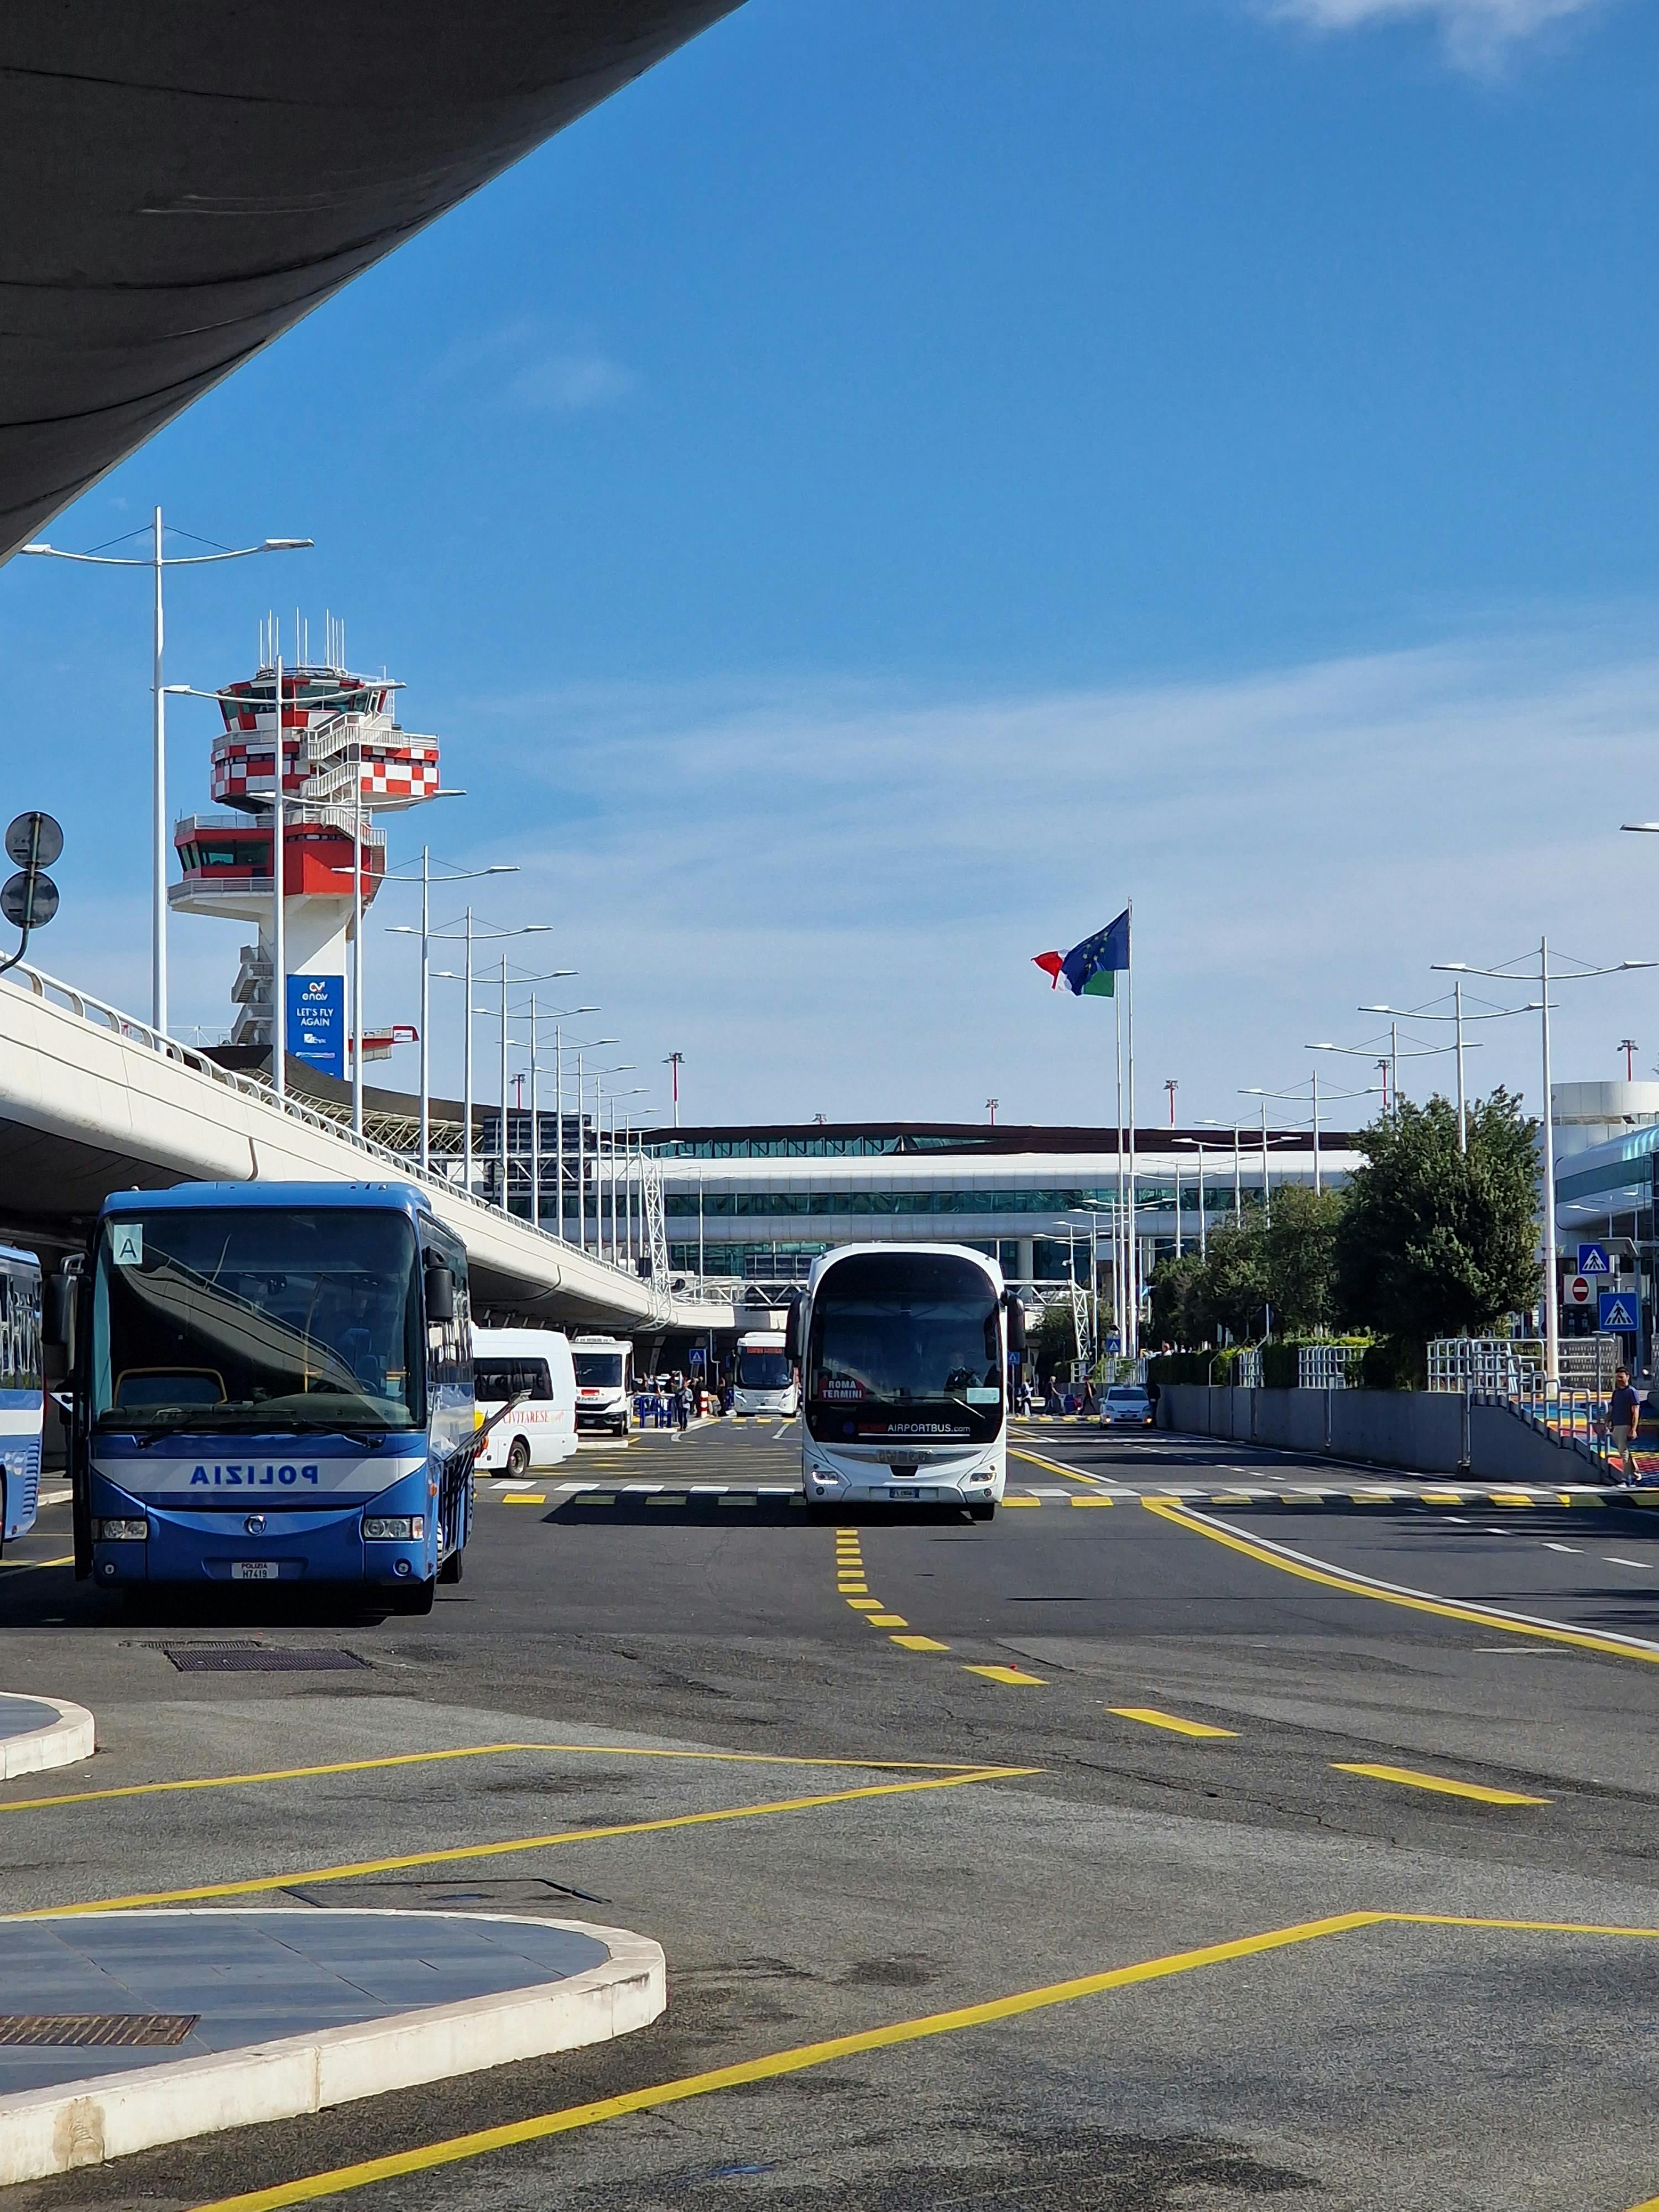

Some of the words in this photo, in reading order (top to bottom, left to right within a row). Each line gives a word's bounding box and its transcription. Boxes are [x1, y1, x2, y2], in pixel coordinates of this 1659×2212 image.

[296, 1008, 318, 1016] LET'S
[320, 1008, 333, 1016] FLY
[300, 1018, 330, 1026] AGAIN
[119, 1238, 137, 1258] A
[828, 1380, 856, 1389] ROMA
[822, 1390, 862, 1399] TERMINI
[243, 1569, 267, 1578] H7419
